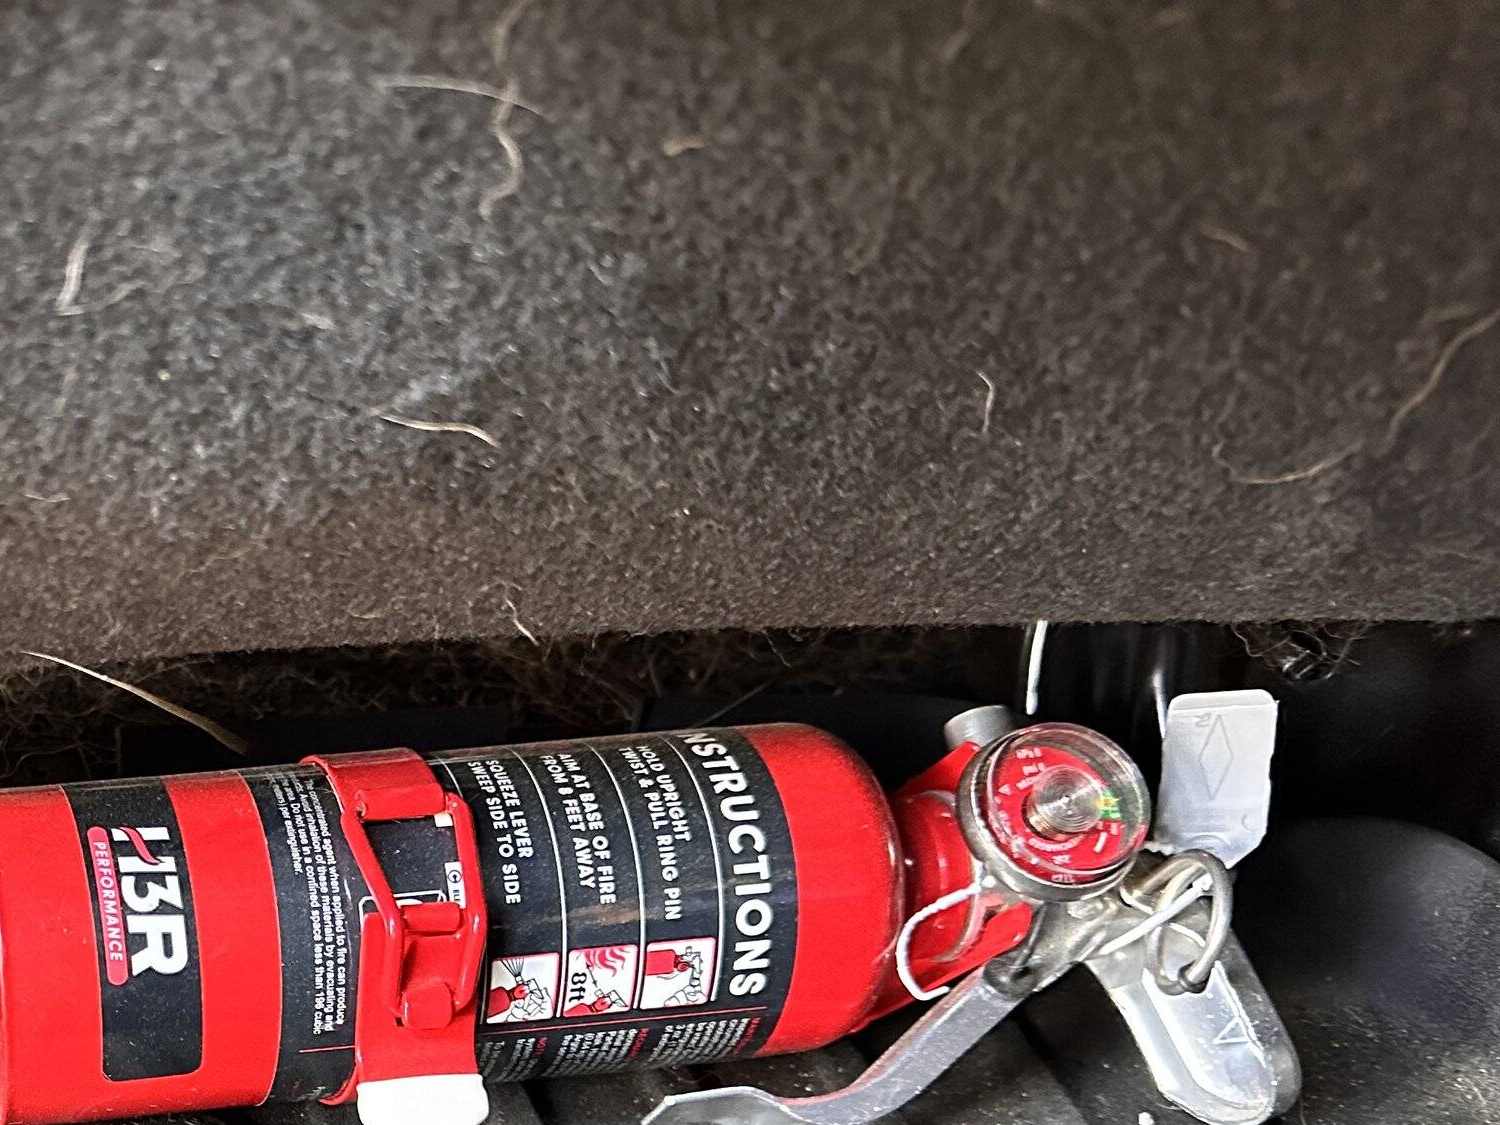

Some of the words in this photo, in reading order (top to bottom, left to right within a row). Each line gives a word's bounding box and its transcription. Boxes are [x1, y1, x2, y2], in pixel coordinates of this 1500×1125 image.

[540, 755, 569, 784] FROM
[557, 754, 581, 771] AIM
[619, 747, 649, 775] TWIST
[467, 761, 495, 793] SWEEP
[557, 786, 574, 795] 8
[570, 774, 590, 789] AT
[639, 778, 655, 788] &
[290, 803, 301, 814] Do
[299, 793, 313, 812] Avoid
[485, 760, 521, 807] SQUEEZE
[509, 811, 534, 858] LEVER
[636, 746, 665, 771] HOLD
[656, 774, 691, 842] UPRIGHT
[294, 815, 306, 827] not
[308, 791, 331, 837] concentrated
[486, 797, 508, 830] SIDE
[562, 799, 586, 832] FEET
[578, 792, 604, 831] BASE
[644, 792, 669, 829] PULL
[278, 807, 291, 819] per
[285, 820, 304, 876] extinguisher.
[297, 829, 309, 845] use
[305, 813, 322, 852] inhalation
[496, 833, 514, 858] TO
[592, 835, 611, 860] OF
[302, 846, 312, 855] in
[315, 855, 326, 864] of
[321, 838, 337, 865] agent
[572, 837, 596, 889] AWAY
[656, 834, 675, 882] RING
[676, 732, 774, 996] NSTRUCTIONS
[305, 866, 321, 907] confined
[316, 866, 329, 893] these
[328, 866, 340, 893] when
[501, 863, 522, 904] SIDE
[597, 865, 617, 905] FIRE
[92, 840, 124, 961] PERFORMANCE
[110, 826, 189, 977] H3R
[331, 895, 346, 932] applied
[664, 887, 682, 921] PIN
[310, 910, 322, 941] space
[321, 895, 334, 943] materials
[314, 943, 325, 964] less
[324, 944, 336, 957] by
[336, 935, 346, 946] to
[337, 947, 347, 964] fire
[314, 966, 325, 989] than
[323, 960, 336, 1013] evacuating
[337, 966, 346, 985] can
[568, 972, 588, 1003] 8ft
[335, 987, 347, 1025] produce
[312, 1011, 324, 1035] cubic
[324, 1015, 336, 1031] and
